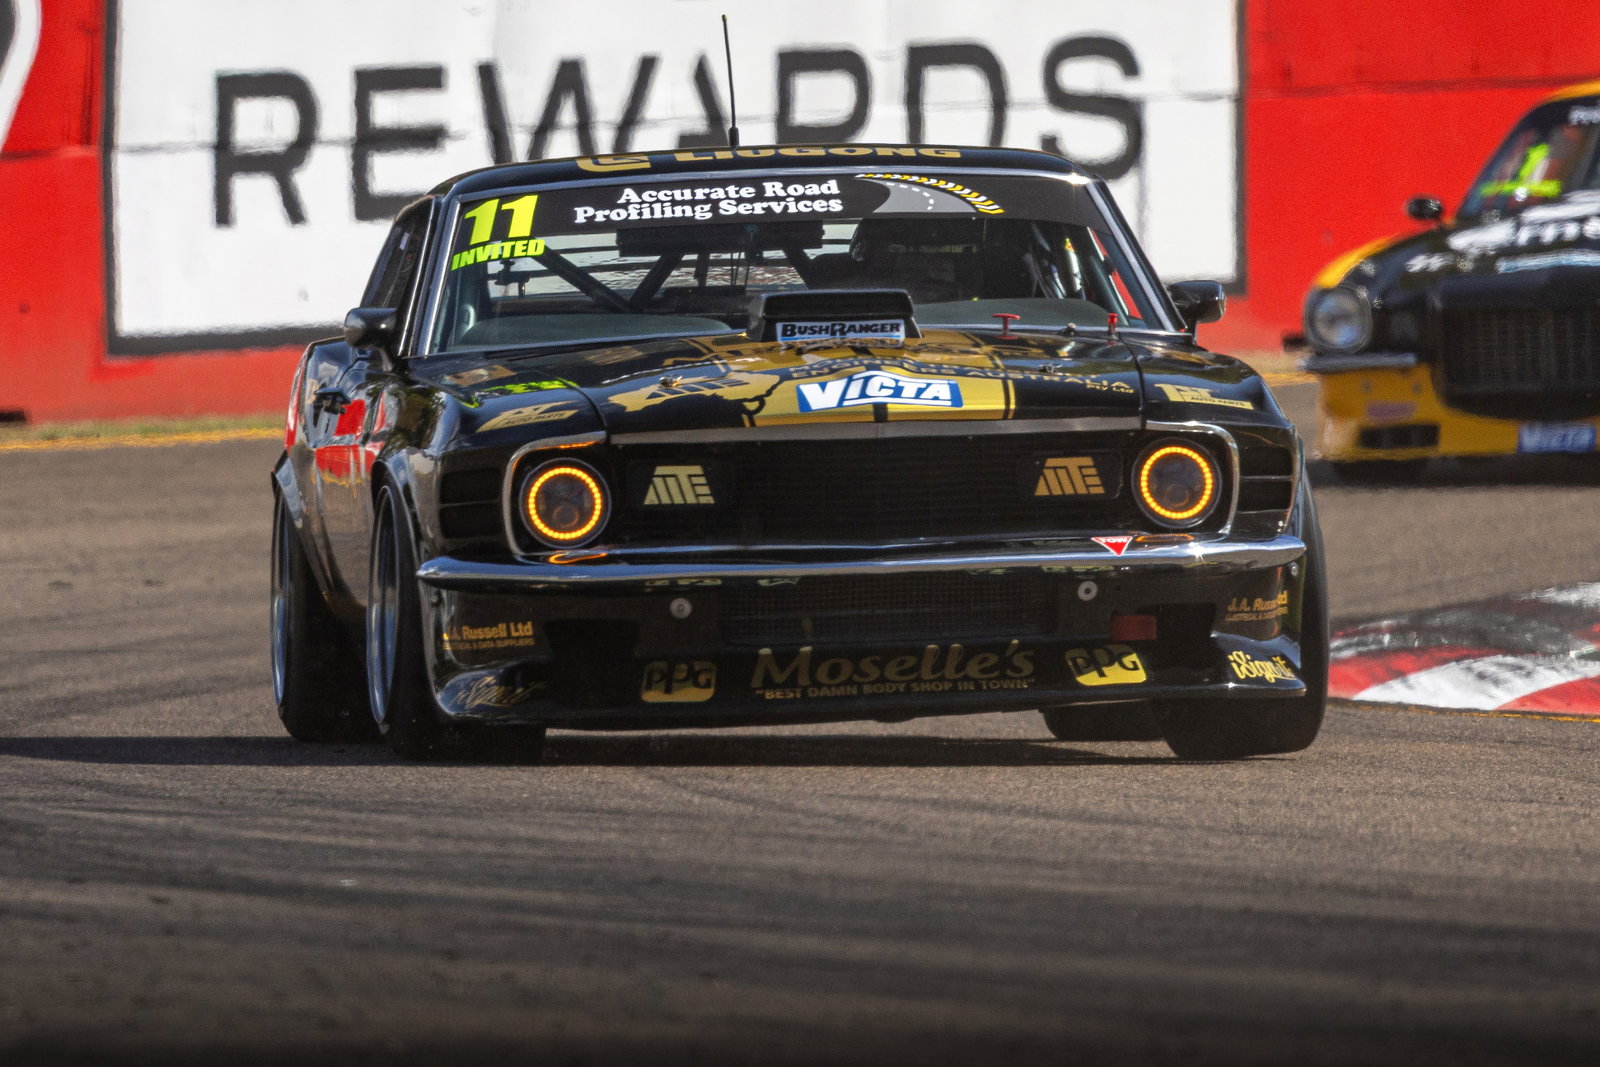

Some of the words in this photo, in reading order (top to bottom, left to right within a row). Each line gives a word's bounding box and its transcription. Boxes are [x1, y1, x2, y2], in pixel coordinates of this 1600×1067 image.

[214, 33, 1144, 228] REWARDS
[617, 184, 756, 204] Accurate
[762, 179, 840, 198] Road
[464, 194, 539, 246] 11
[574, 202, 713, 224] Profiling
[719, 197, 843, 216] Services
[451, 239, 546, 271] INVITED
[461, 623, 507, 640] Russell
[510, 621, 534, 637] Ltd
[646, 660, 713, 694] PPG
[751, 640, 1034, 688] Moselle's
[1068, 648, 1141, 678] PPG
[808, 684, 858, 697] DAMN
[863, 680, 905, 694] BODY
[911, 679, 951, 692] SHOP
[958, 679, 975, 691] IN
